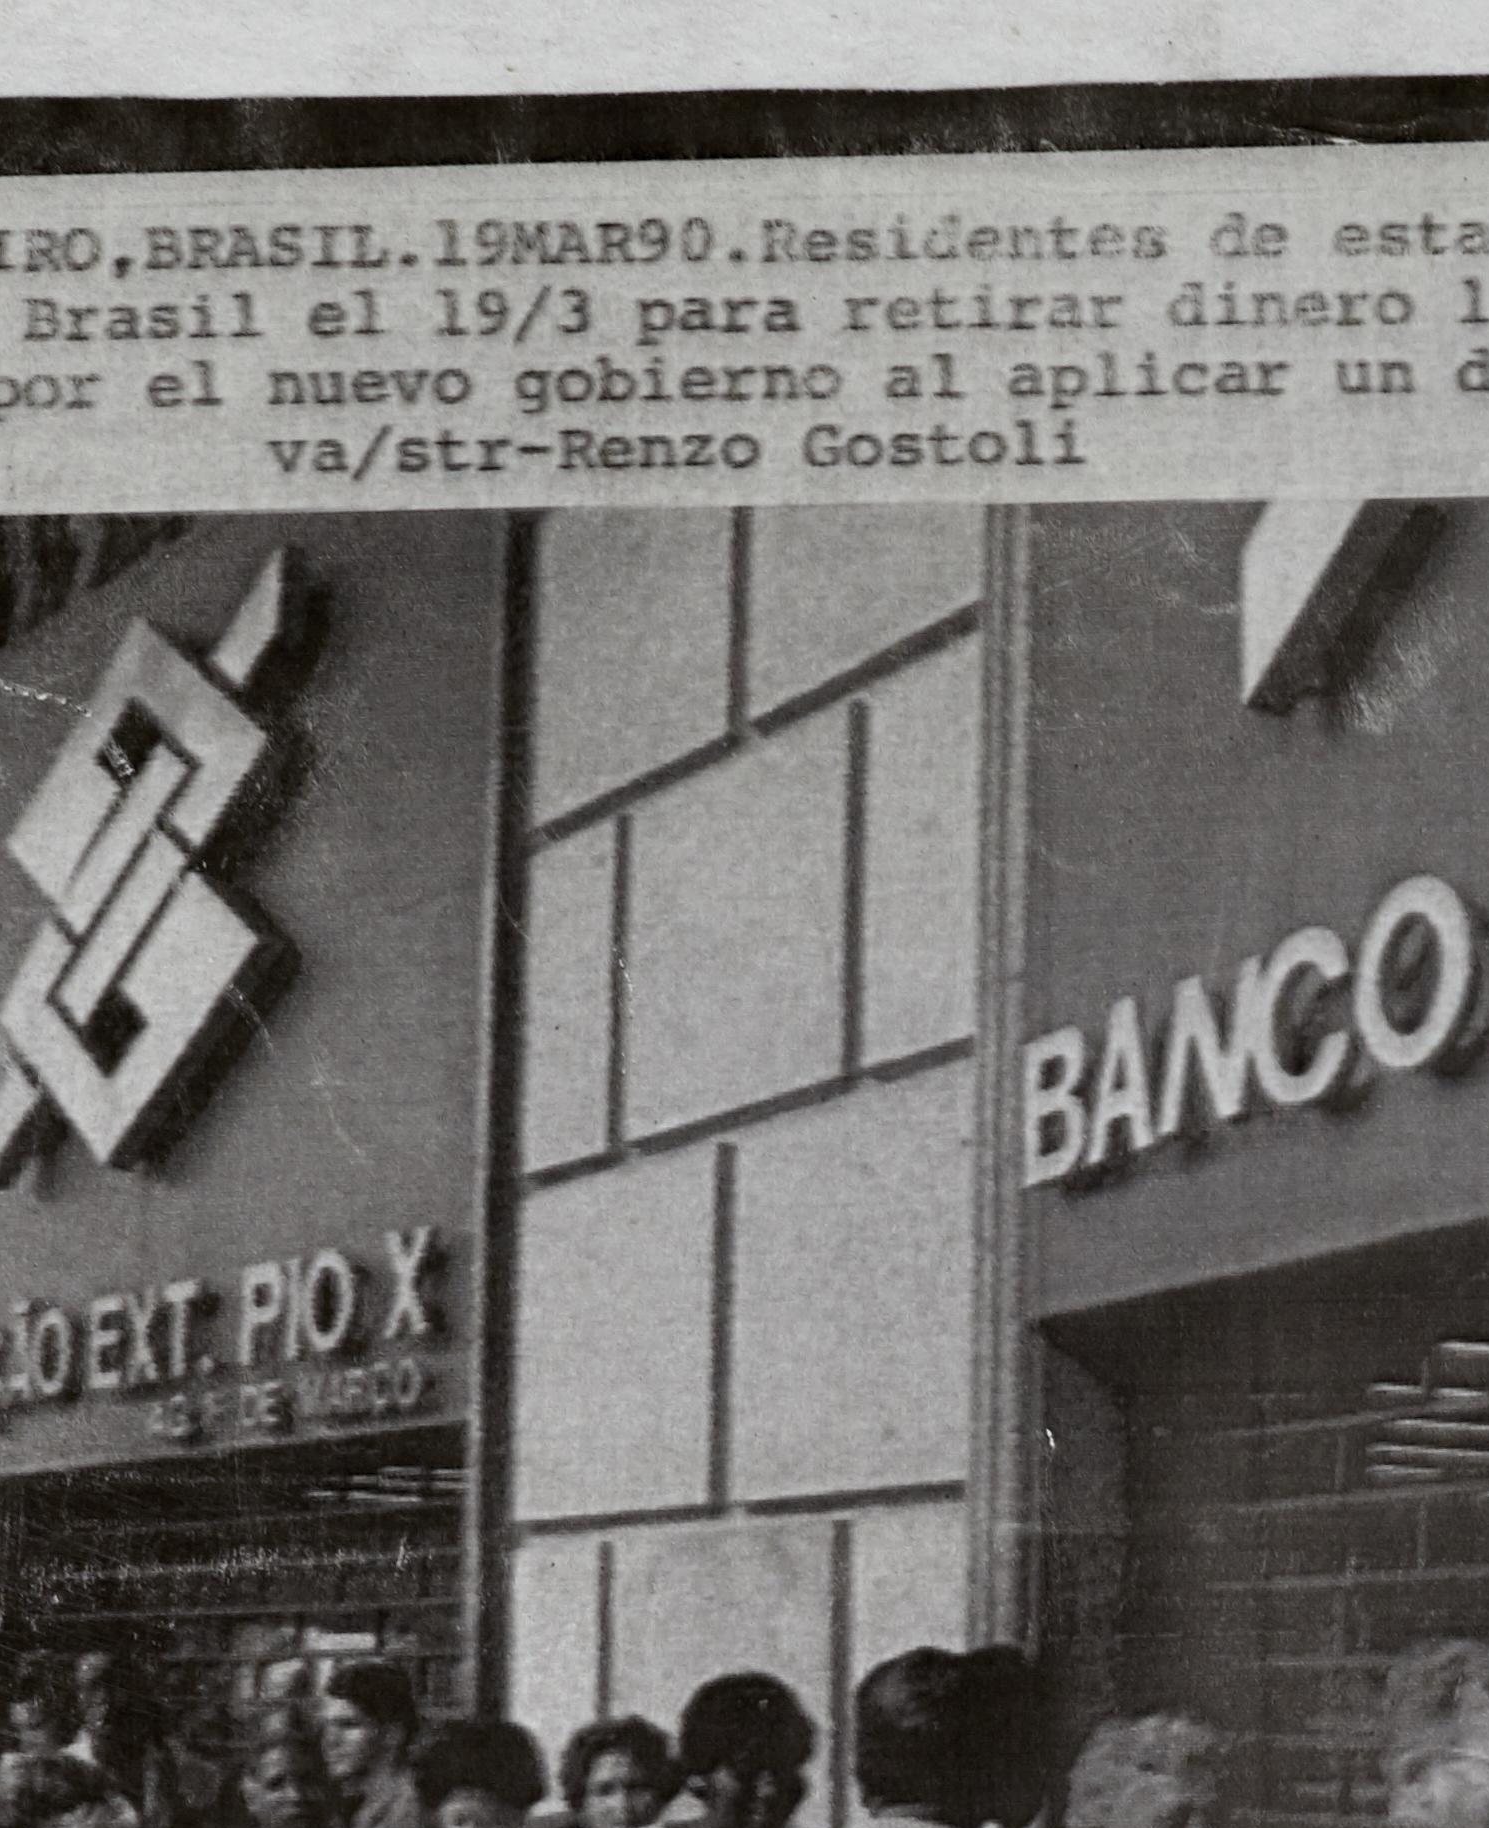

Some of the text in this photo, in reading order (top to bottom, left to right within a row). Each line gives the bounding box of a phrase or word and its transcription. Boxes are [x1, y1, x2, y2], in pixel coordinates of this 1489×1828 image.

[1020, 876, 1481, 1190] BANCO
[87, 1279, 214, 1391] EXT.
[239, 1247, 354, 1367] PIO
[384, 1224, 434, 1341] X
